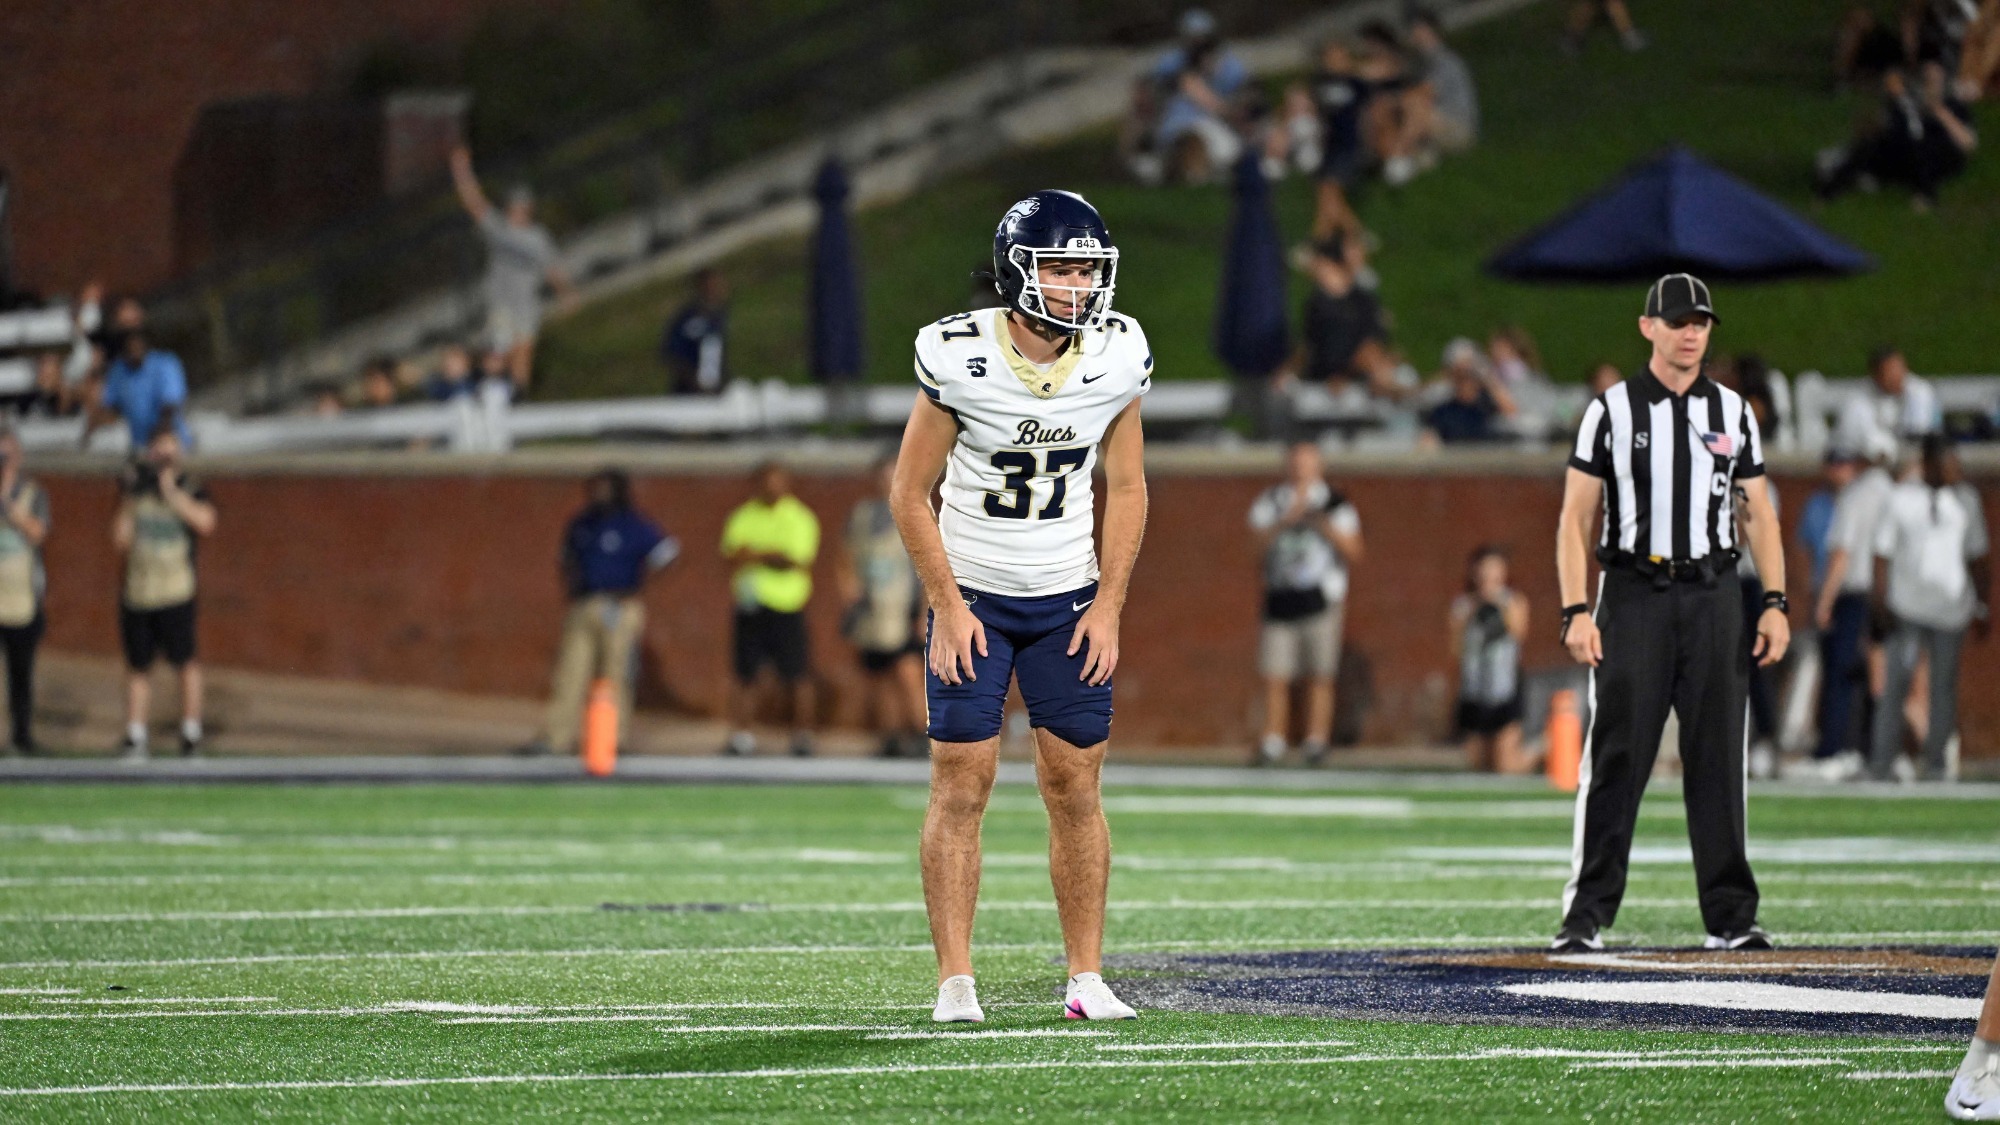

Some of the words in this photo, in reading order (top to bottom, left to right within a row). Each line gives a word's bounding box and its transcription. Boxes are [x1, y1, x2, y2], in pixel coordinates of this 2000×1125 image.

[1076, 239, 1096, 248] 843
[1012, 419, 1077, 446] Bucs
[1634, 431, 1649, 449] S
[982, 446, 1091, 520] 37
[1711, 472, 1728, 496] C
